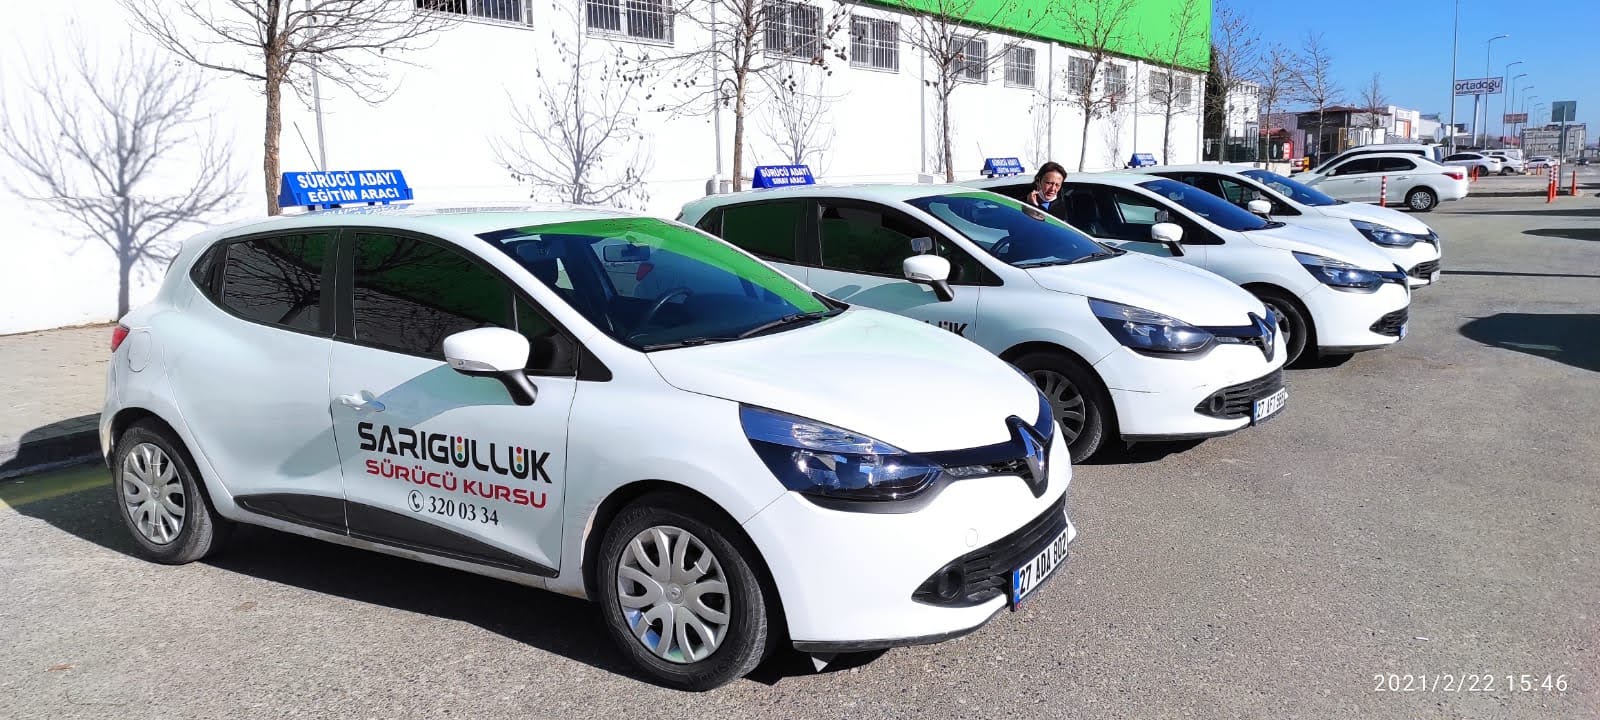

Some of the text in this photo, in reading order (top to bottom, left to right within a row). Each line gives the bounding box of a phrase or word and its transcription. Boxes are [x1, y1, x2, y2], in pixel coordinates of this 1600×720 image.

[297, 171, 398, 188] SÜRÜCÜ ADAYI
[307, 187, 400, 202] EĞİTİM ARACI
[1257, 401, 1265, 417] 27
[366, 458, 547, 509] SÜRÜCÜ KURSU
[428, 496, 499, 525] 320 03 34
[1020, 532, 1067, 595] 27 ADA 802
